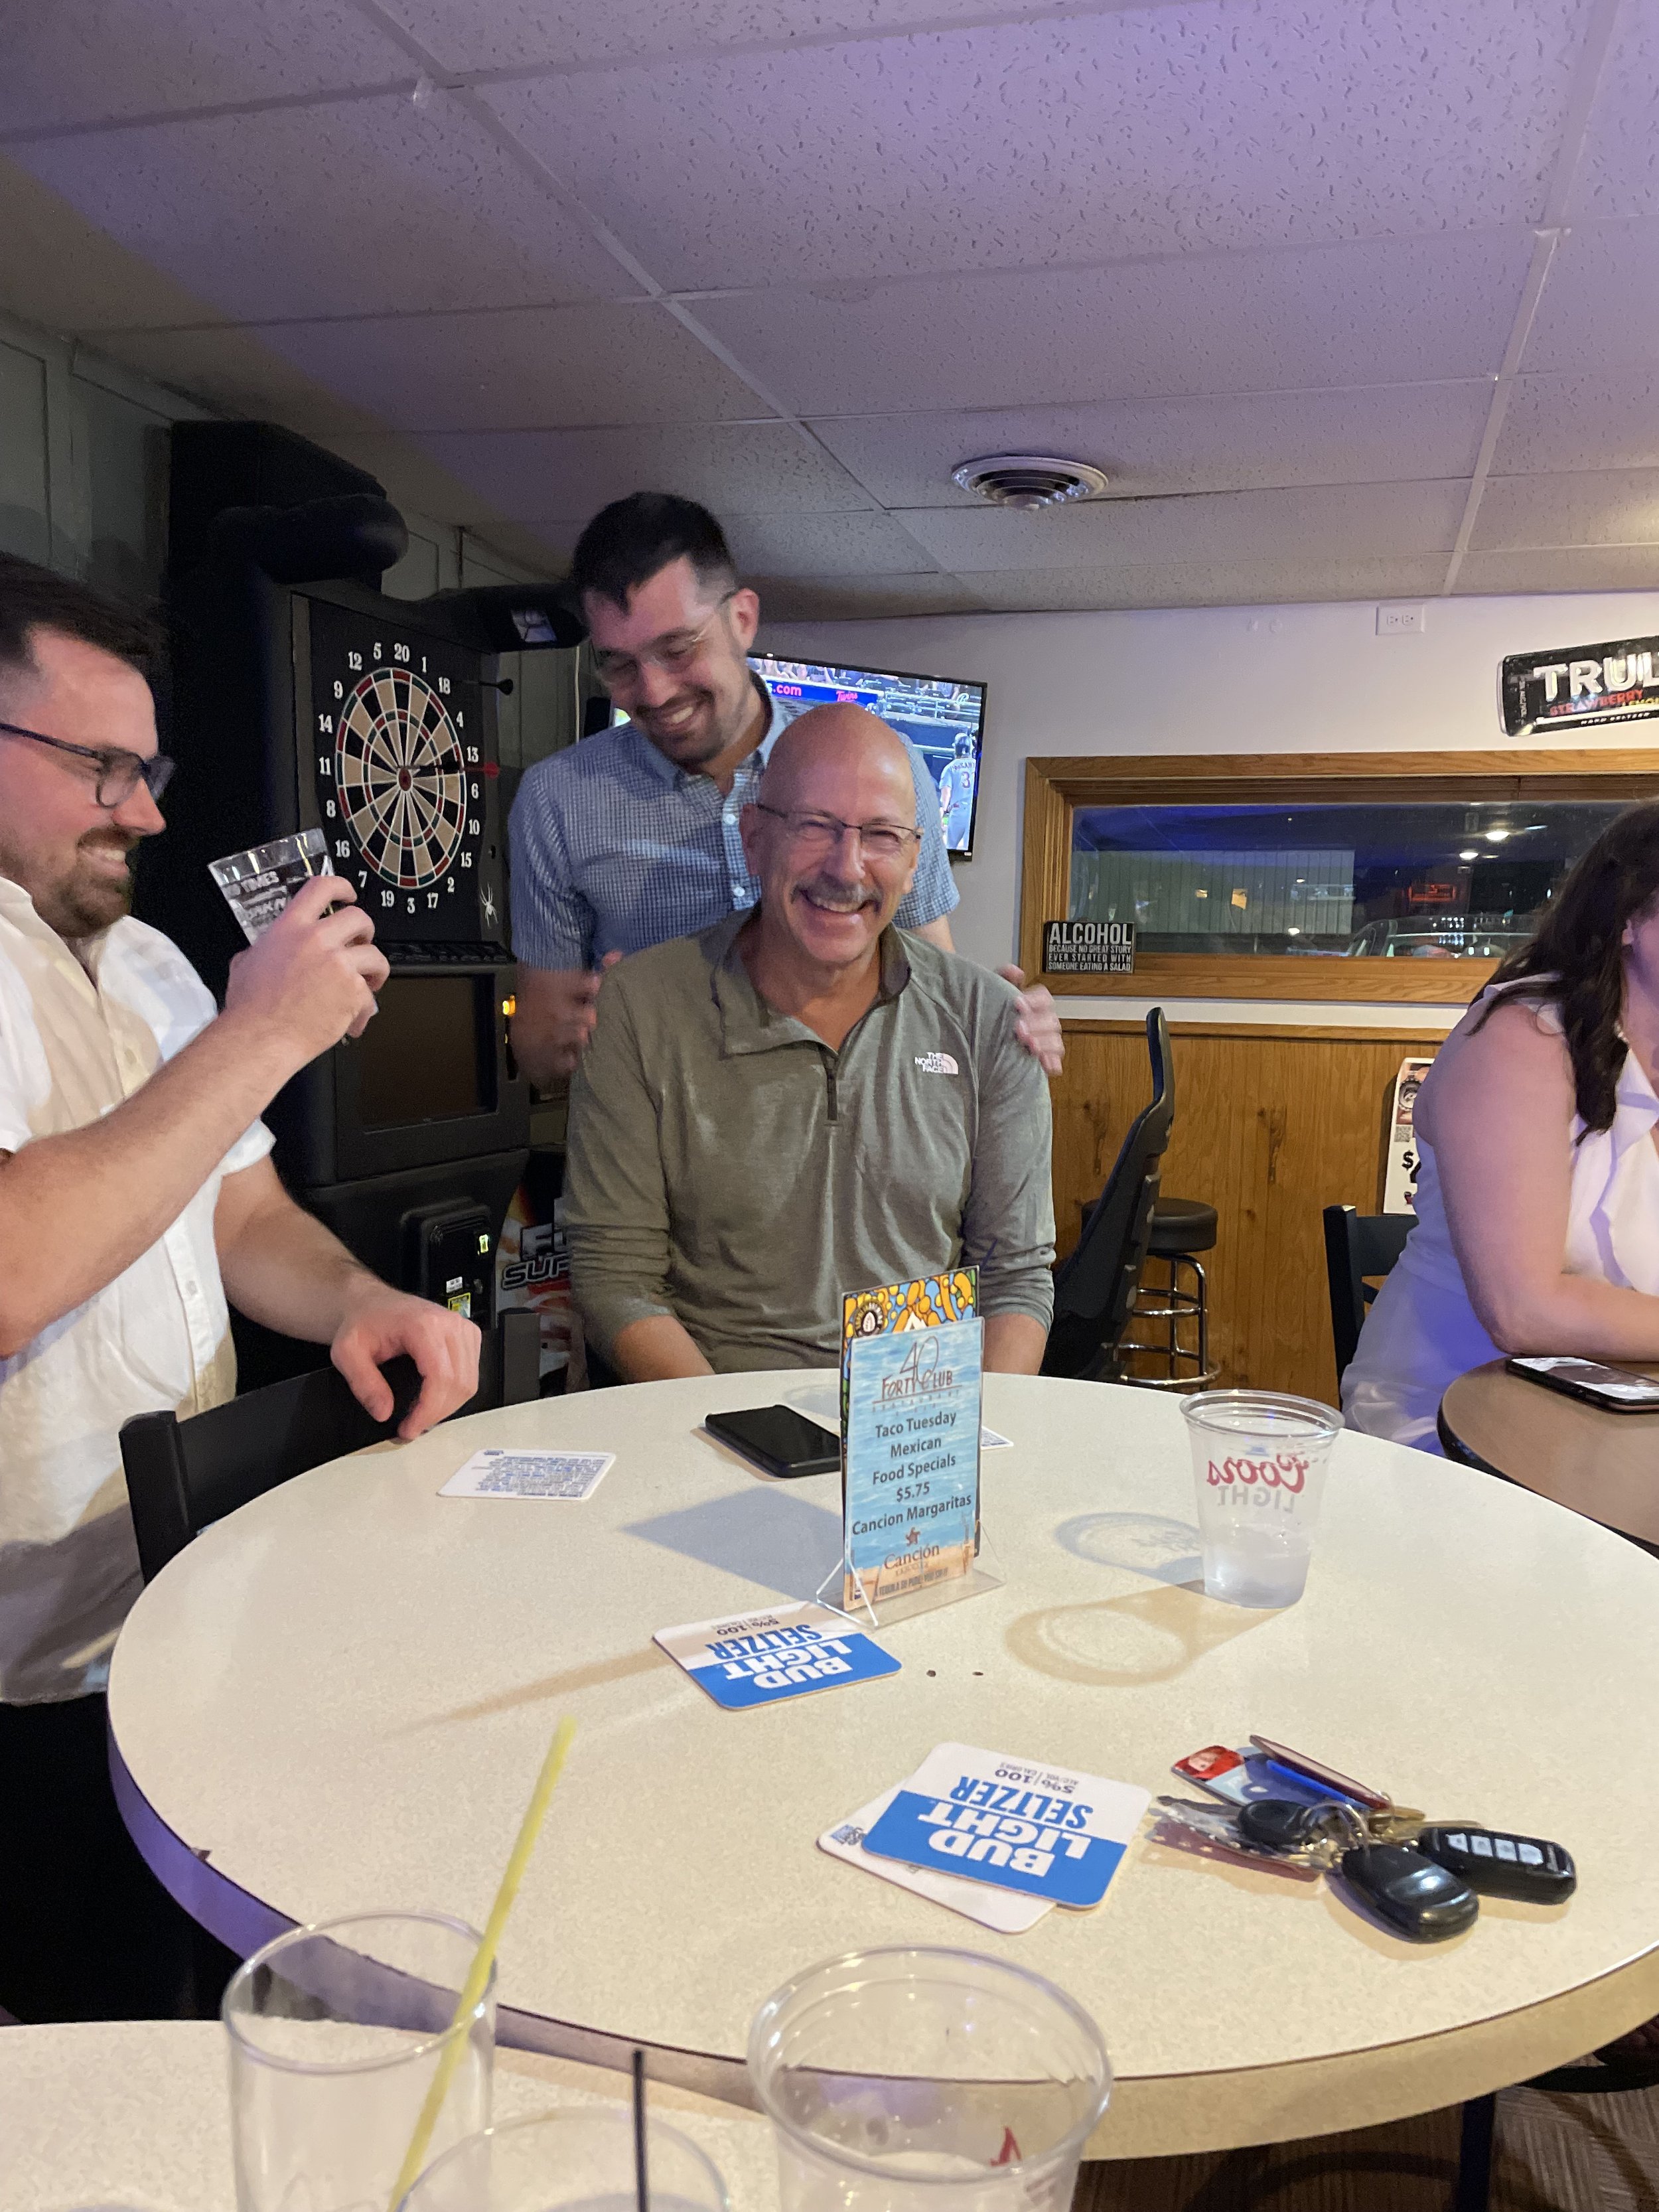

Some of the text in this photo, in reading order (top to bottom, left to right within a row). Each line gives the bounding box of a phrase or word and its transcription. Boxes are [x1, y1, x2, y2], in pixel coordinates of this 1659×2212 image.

[373, 642, 382, 660] 5
[394, 642, 410, 662] 20
[348, 651, 362, 671] 12
[421, 656, 427, 673] 1
[438, 676, 451, 694] 18
[1533, 651, 1659, 702] TRUL
[333, 680, 343, 700] 9
[835, 690, 858, 702] Twins
[1550, 690, 1643, 717] STRAWBERRY
[318, 713, 333, 734] 14
[456, 711, 464, 727] 4
[467, 745, 479, 763] 13
[319, 757, 331, 776] 11
[471, 782, 479, 799] 6
[326, 800, 336, 818] 8
[469, 818, 480, 836] 10
[335, 840, 350, 858] 16
[461, 851, 472, 868] 15
[358, 870, 368, 888] 7
[447, 876, 455, 893] 2
[380, 890, 395, 907] 19
[407, 897, 415, 914] 3
[427, 892, 439, 909] 17
[1049, 922, 1132, 945] ALCOHOL
[1048, 944, 1131, 954] BECAUSE NO GREAT STORY
[1110, 954, 1131, 962] WITH
[1048, 962, 1078, 971] SOMEONE
[1080, 962, 1102, 971] EATING
[1110, 963, 1131, 972] SALAD
[899, 1335, 939, 1382] 40
[881, 1369, 953, 1400] FORTY CLUB
[875, 1410, 957, 1439] Taco Tuesday
[891, 1437, 942, 1458] Mexican
[873, 1453, 956, 1485] Food Specials
[897, 1481, 930, 1503] $5.75
[852, 1495, 972, 1535] Cancion Margaritas
[717, 1625, 747, 1635] 100
[705, 1623, 823, 1661] SELTZER
[725, 1639, 853, 1680] LIGHT
[753, 1657, 853, 1689] BUD
[995, 1769, 1033, 1783] 100
[949, 1775, 1094, 1830] SELTZER
[917, 1800, 1092, 1860] LIGHT
[927, 1827, 1056, 1878] BUD
